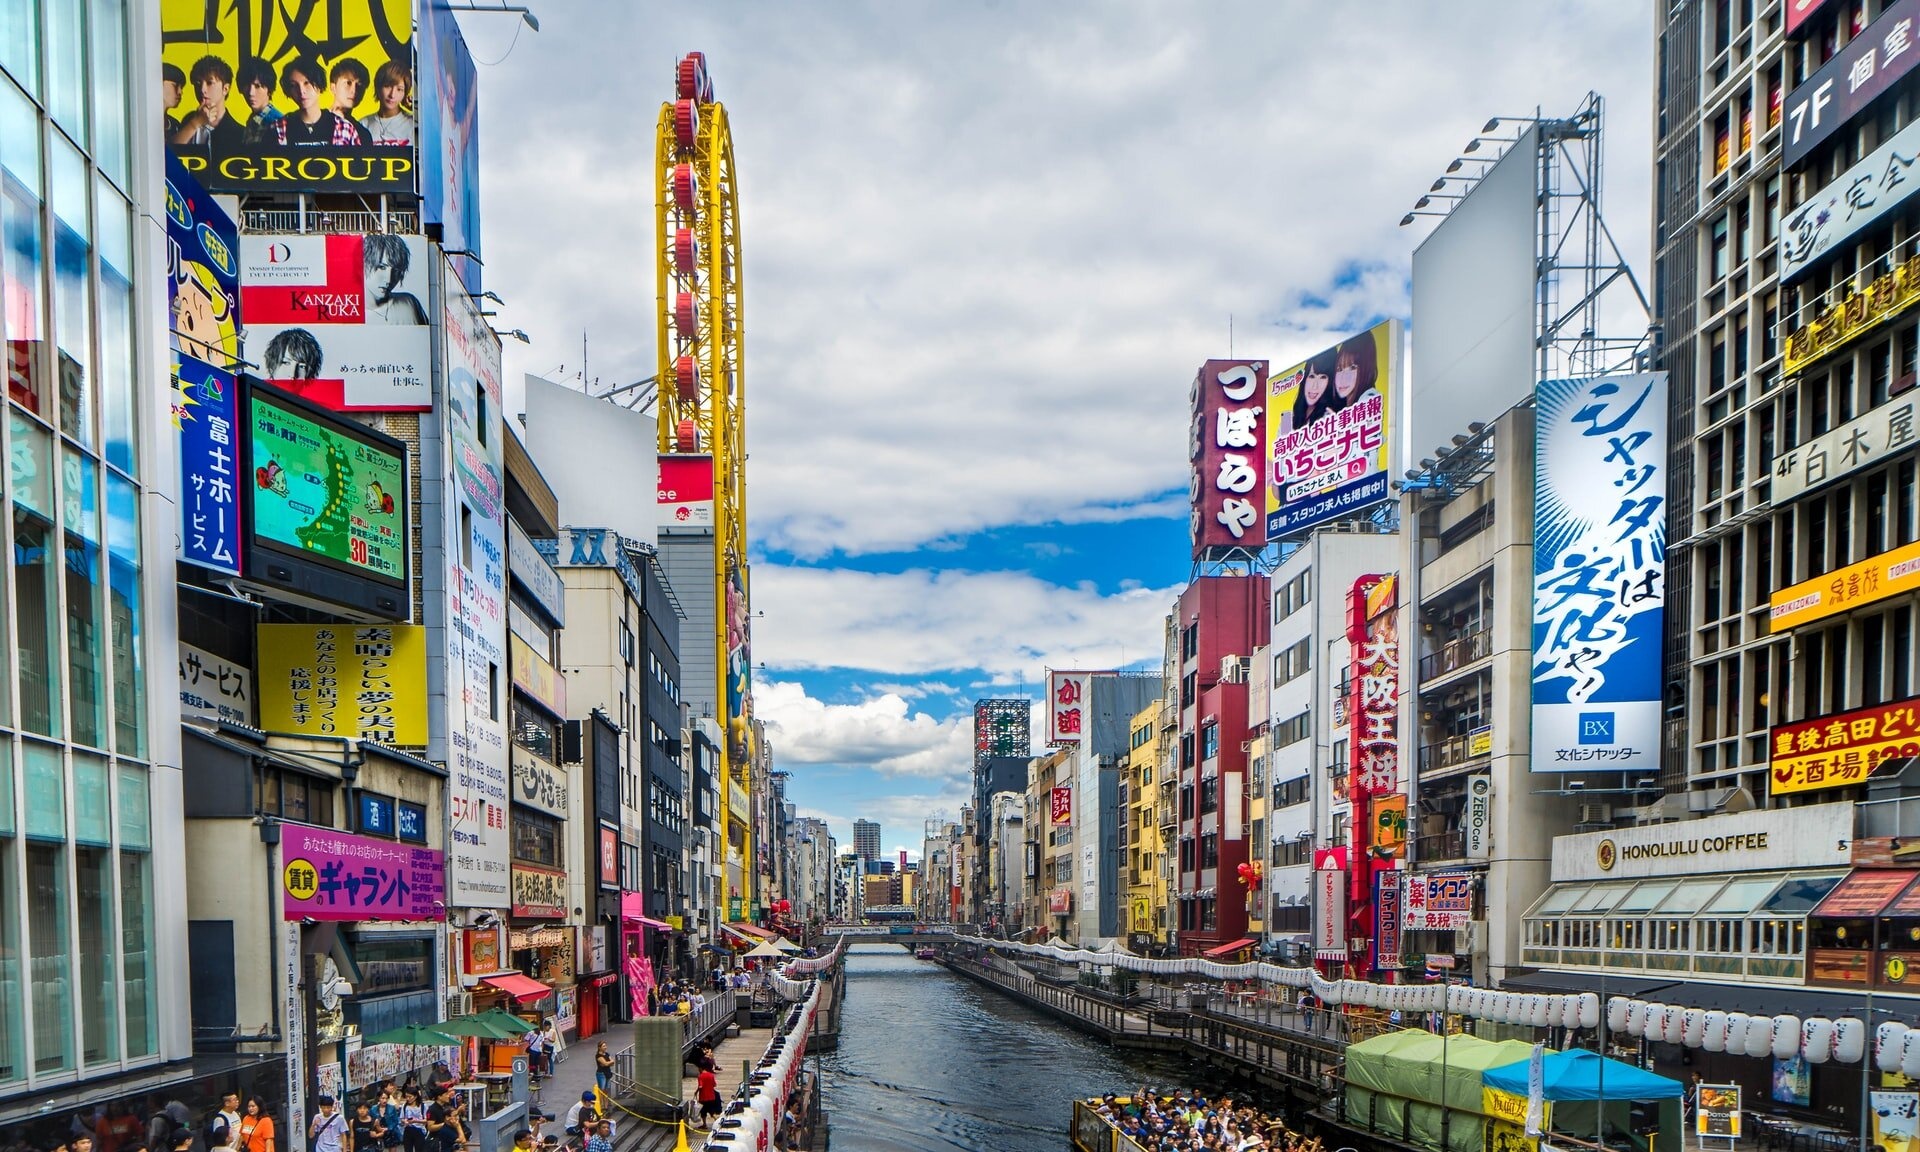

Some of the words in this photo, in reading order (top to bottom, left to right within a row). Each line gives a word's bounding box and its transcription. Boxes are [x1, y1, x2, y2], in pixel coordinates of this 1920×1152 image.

[1790, 78, 1833, 146] 7F
[220, 156, 412, 181] GROUP
[1845, 151, 1915, 223] 完全
[291, 291, 360, 312] KANZAKI
[317, 304, 360, 321] RUKA
[339, 363, 414, 375] めっちゃ面白いを
[392, 376, 425, 387] 仕事に。
[267, 410, 309, 431] 富士ホームサービス
[1274, 395, 1382, 456] 高収入お仕事情報
[1217, 362, 1263, 538] づぼらや
[1274, 416, 1382, 484] いちごナビ
[1776, 451, 1798, 480] 4F
[1804, 407, 1917, 488] 白木屋
[366, 455, 399, 472] 富士グループ
[207, 414, 233, 565] 富士ホーム
[1289, 478, 1326, 498] いちごナビ
[1327, 470, 1343, 486] 求人
[190, 473, 207, 551] サービス
[1269, 478, 1385, 531] 店舗・スタッフ求人も掲載中!
[351, 538, 366, 565] 30
[1771, 595, 1816, 617] TORIKIZOKU
[1829, 565, 1879, 606] 鳥貴族
[316, 629, 337, 733] あなたのお店づくり
[353, 628, 397, 743] 素晴らしい夢の実現
[291, 667, 312, 726] 応援します
[1359, 634, 1398, 792] 大阪王将
[1584, 720, 1610, 737] BX
[1555, 747, 1643, 762] 文化シャッター
[1796, 752, 1863, 784] 酒場
[453, 797, 478, 823] コスパ
[1053, 793, 1061, 817] ドラッグ
[1061, 790, 1069, 811] ツルハ
[303, 836, 408, 864] あなたも憧れのお店のオーナーに!
[1622, 838, 1698, 860] HONOLULU
[1702, 832, 1769, 853] COFFEE
[289, 868, 314, 891] 賃貸
[319, 860, 410, 908] ギャラント
[1409, 878, 1425, 908] 薬
[1428, 880, 1469, 899] ダイコク
[317, 895, 323, 905] の
[1382, 891, 1395, 931] ダイコク
[1425, 912, 1451, 928] 免税
